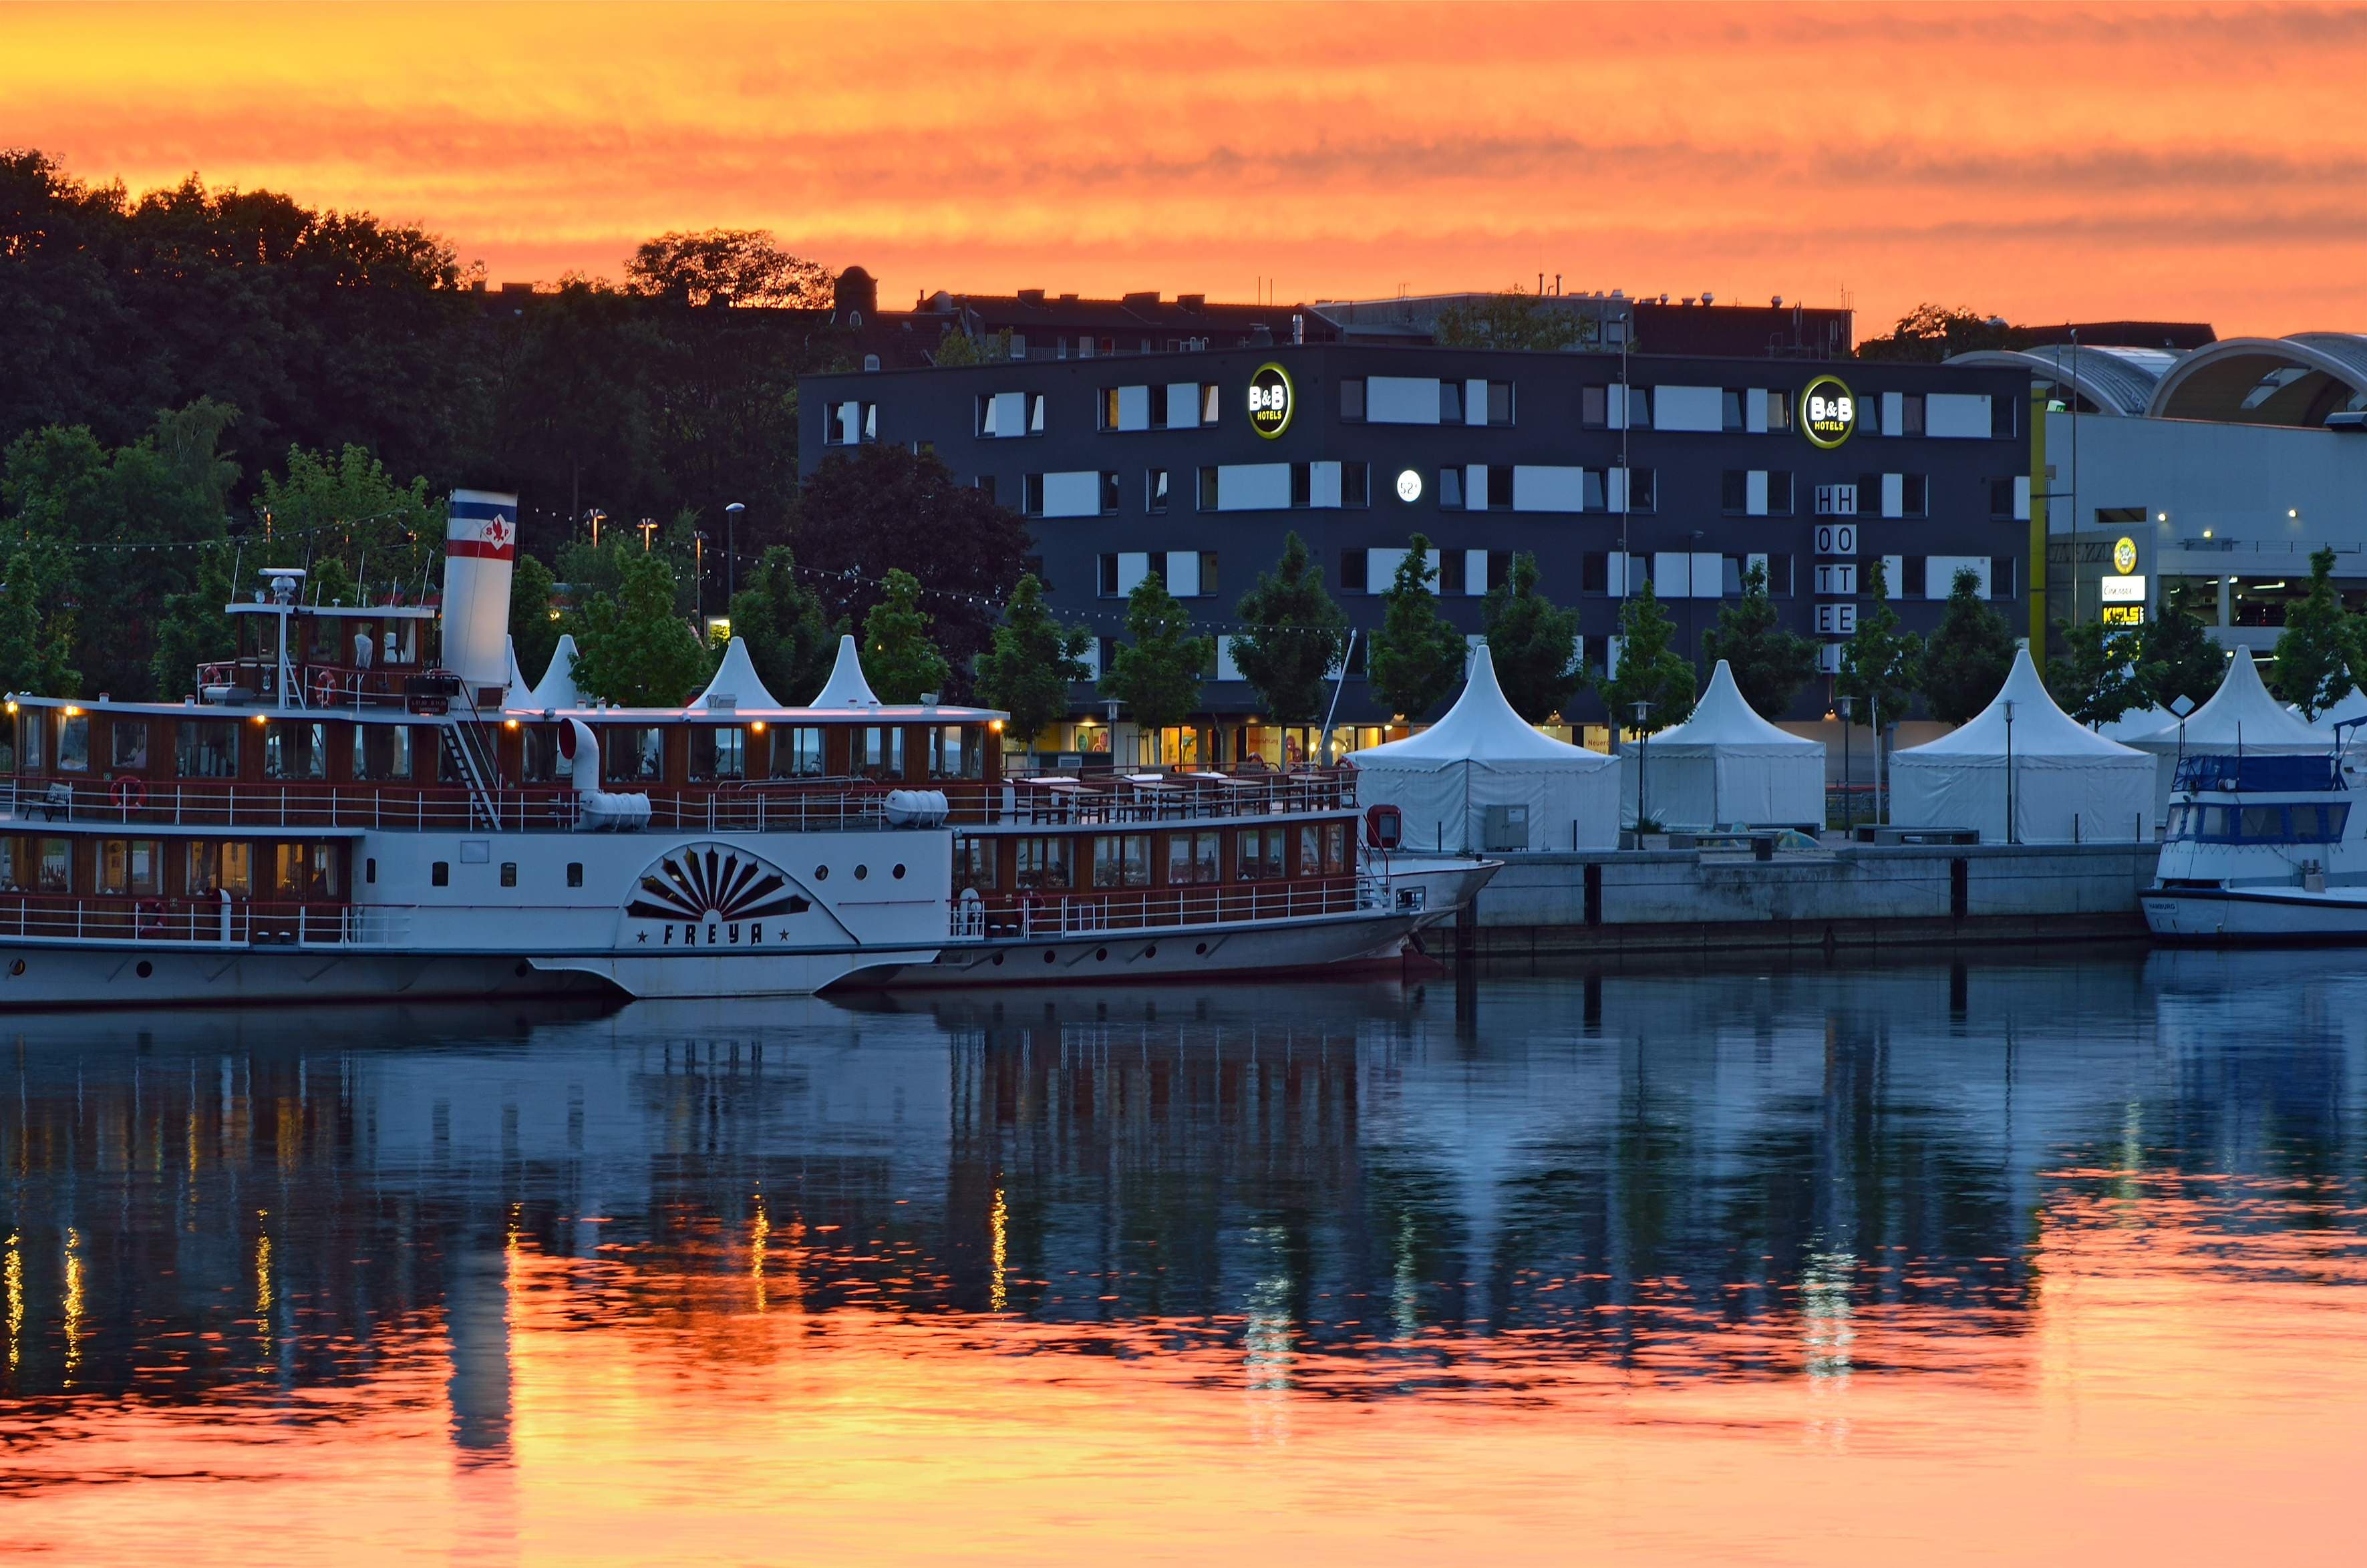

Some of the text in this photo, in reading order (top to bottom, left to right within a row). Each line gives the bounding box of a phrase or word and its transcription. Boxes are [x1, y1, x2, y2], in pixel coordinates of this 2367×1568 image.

[1249, 385, 1283, 410] B&B
[1257, 411, 1281, 420] HOTELS
[1811, 397, 1853, 421] B&B
[1814, 421, 1844, 430] HOTELS
[486, 527, 492, 535] S
[663, 923, 762, 946] FREYA
